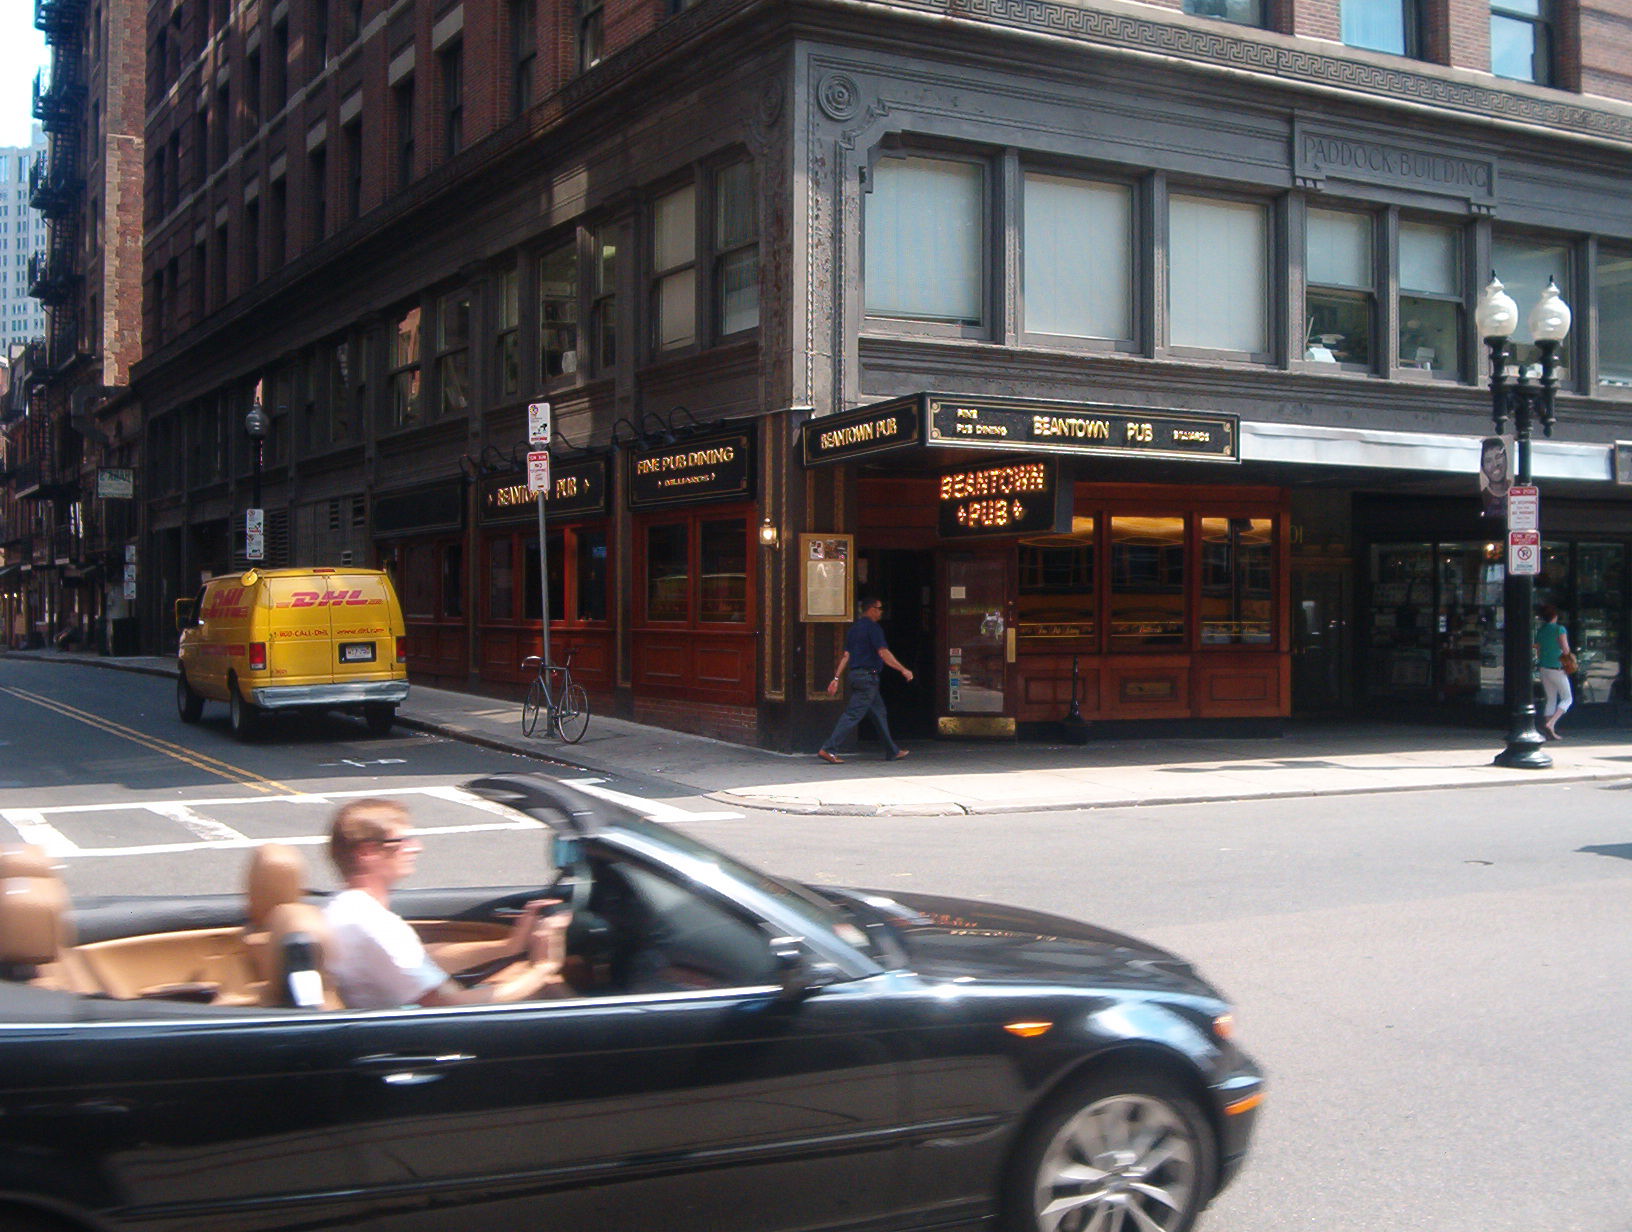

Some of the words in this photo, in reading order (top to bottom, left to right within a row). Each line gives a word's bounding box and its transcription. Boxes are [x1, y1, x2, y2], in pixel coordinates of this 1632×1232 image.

[1302, 135, 1393, 174] PADDOCK
[1399, 153, 1488, 188] BUILDING
[820, 422, 874, 449] BEANTOWN
[875, 417, 898, 441] PUB
[1033, 415, 1110, 439] BEANTOWN
[1126, 422, 1153, 441] PUB
[637, 458, 660, 476] FINE
[662, 454, 687, 472] PUB
[688, 446, 735, 467] DINING
[497, 484, 549, 507] BEANTO
[556, 476, 577, 500] PUB
[940, 464, 1045, 500] BEANTOWN
[968, 500, 1009, 527] PUB
[290, 589, 369, 609] DHL
